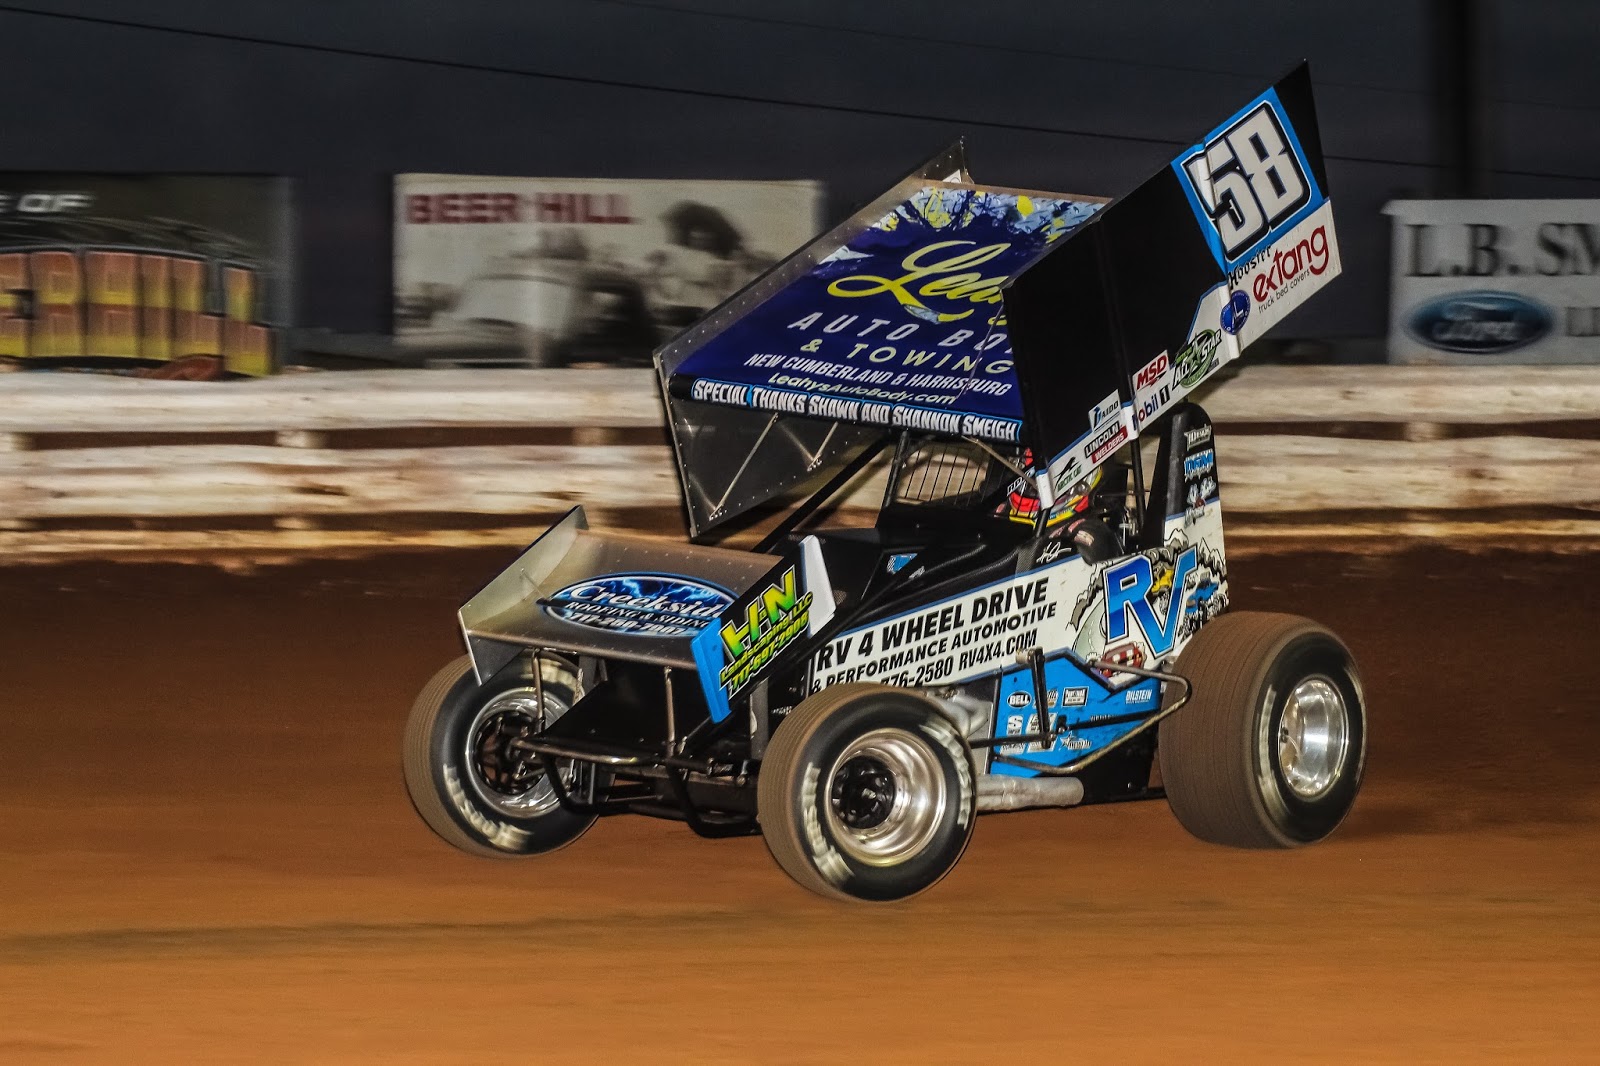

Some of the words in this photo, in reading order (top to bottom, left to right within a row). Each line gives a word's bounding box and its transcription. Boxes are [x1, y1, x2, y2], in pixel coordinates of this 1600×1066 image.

[1184, 104, 1309, 258] 58
[405, 192, 522, 225] BEER
[536, 192, 640, 225] HILL
[827, 240, 1011, 325] Lea
[1228, 245, 1272, 290] Hoosier
[1253, 225, 1329, 302] extang
[1258, 295, 1275, 313] truck
[1276, 283, 1289, 300] bed
[1290, 268, 1310, 289] covers
[788, 311, 920, 341] AUTO
[939, 328, 1013, 354] BO
[744, 352, 783, 369] NEW
[782, 355, 895, 386] CUMBERLAND
[890, 372, 904, 386] &
[905, 373, 1013, 397] HARRISBURG
[800, 338, 823, 353] &
[847, 342, 1015, 375] TOWING
[1137, 355, 1167, 390] MSD
[767, 372, 958, 405] LeahysAutoBody.com
[1159, 384, 1170, 406] 1
[692, 380, 748, 406] SPECIAL
[751, 386, 806, 414] THANKS
[808, 394, 860, 421] SHAWN
[861, 404, 890, 425] AND
[892, 406, 961, 434] SHANNON
[962, 416, 1019, 442] SMEIGH
[1084, 421, 1120, 459] LINCOLN
[1095, 431, 1125, 462] WELDERS
[565, 601, 641, 619] ROOFING
[570, 585, 725, 618] Creeksid
[791, 591, 813, 618] LLC
[1103, 544, 1198, 659] RV
[816, 636, 853, 672] RV
[858, 634, 875, 657] 4
[881, 607, 965, 652] WHEEL
[970, 576, 1050, 625] DRIVE
[826, 641, 948, 688] PERFORMANCE
[950, 601, 1058, 652] AUTOMOTIVE
[958, 628, 1038, 672] RV4X4.COM
[1008, 694, 1030, 706] BELL
